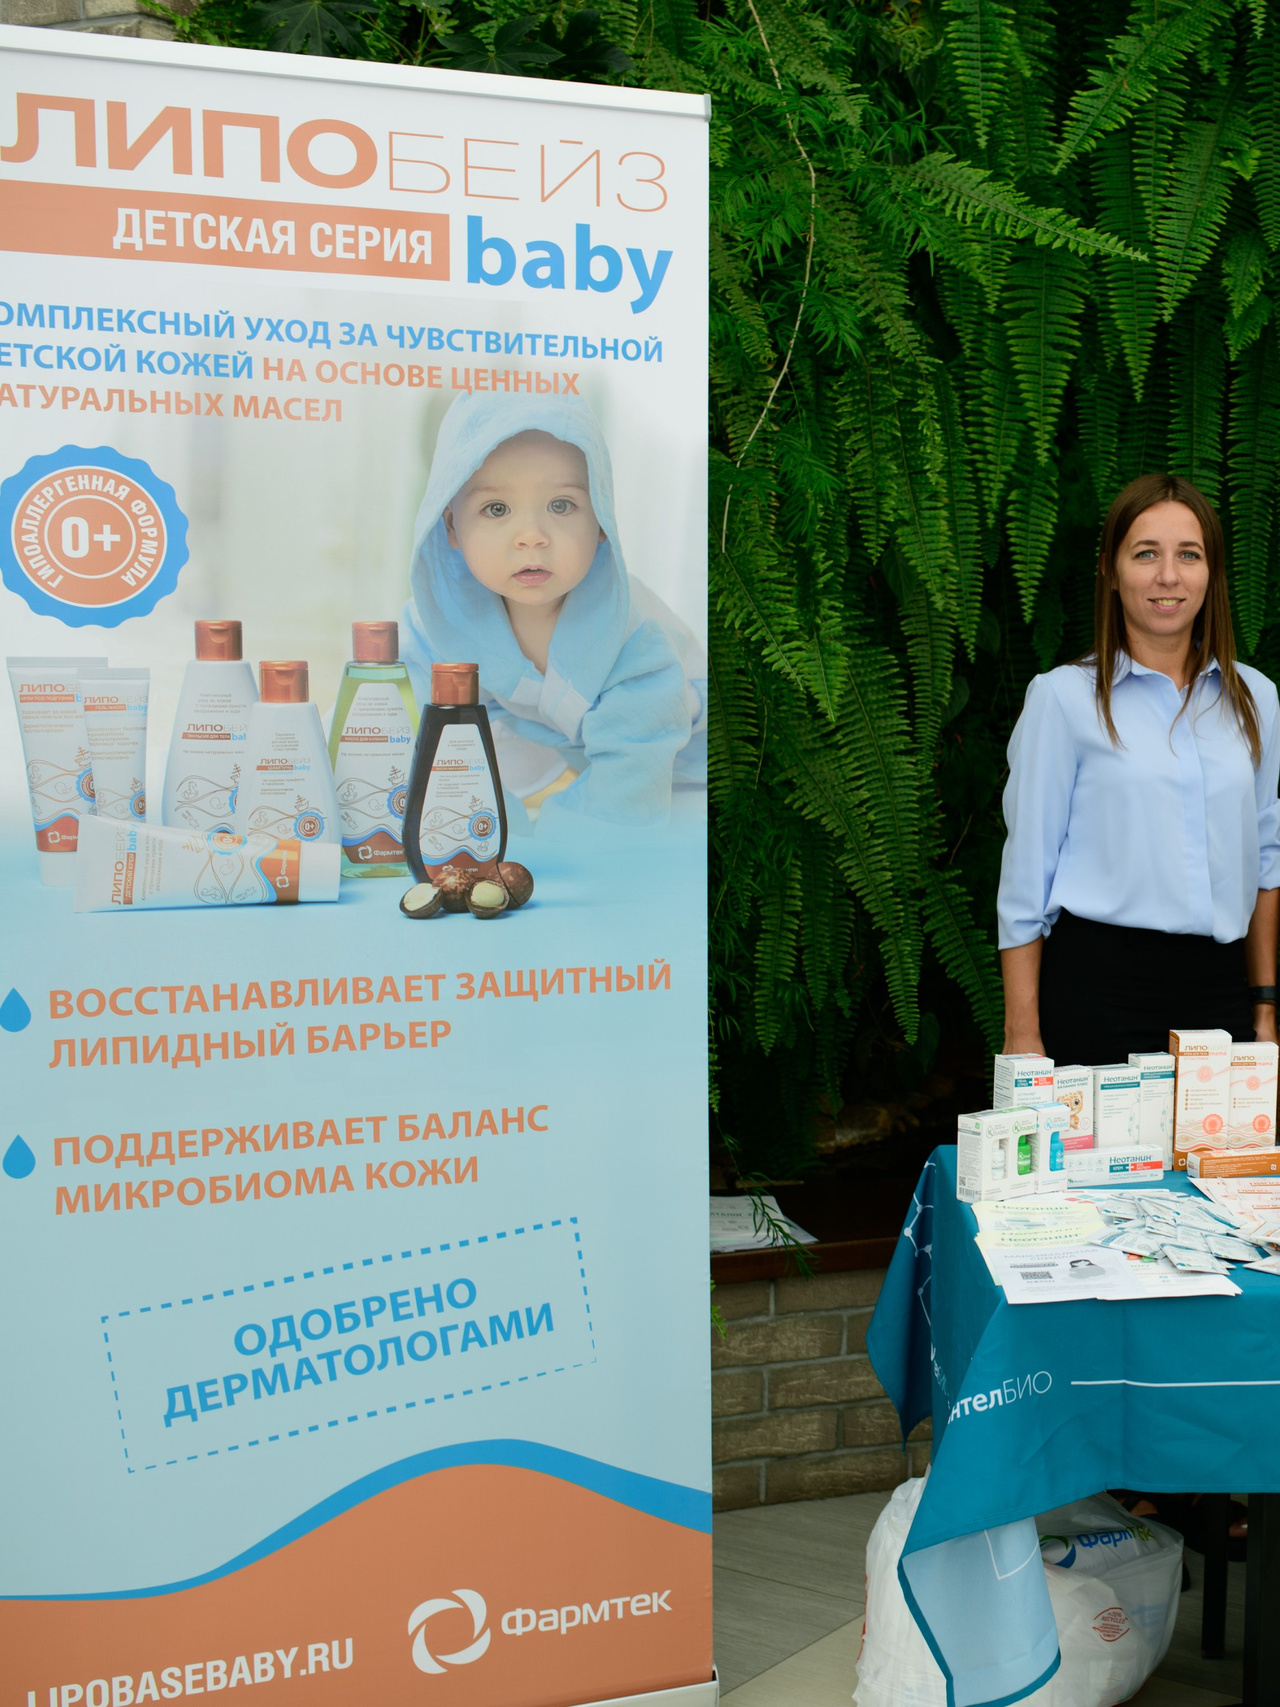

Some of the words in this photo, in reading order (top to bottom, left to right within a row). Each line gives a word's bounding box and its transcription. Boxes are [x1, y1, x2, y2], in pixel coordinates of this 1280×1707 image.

[0, 91, 669, 213] ЛИПОБЕЙЗ
[112, 207, 297, 258] ДЕТСКАЯ
[309, 220, 434, 265] СЕРИЯ
[467, 215, 674, 314] baby
[0, 301, 235, 341] ОМПЛЕКСНЫЙ
[243, 315, 331, 349] УХОД
[339, 321, 378, 347] ЗА
[386, 324, 664, 363] ЧУВСТВИТЕЛЬНОЙ
[0, 342, 126, 373] ЕТСКОЙ
[136, 347, 253, 379] КОЖЕЙ
[262, 357, 306, 383] НА
[314, 359, 443, 389] ОСНОВЕ
[451, 366, 580, 397] ЦЕННЫХ
[0, 383, 224, 419] АТУРАЛЬНЫХ
[233, 395, 343, 422] МАСЕЛ
[21, 474, 131, 589] ГИПОАЛЛЕРГЕННАЯ
[120, 499, 158, 587] ФОРМУЛА
[61, 516, 121, 559] 0+
[390, 735, 411, 745] baby
[48, 973, 447, 1019] ВОССТАНАВЛИВАЕТ
[456, 958, 672, 1002] ЗАЩИТНЫЙ
[49, 1021, 296, 1069] ЛИПИДНЫЙ
[306, 1020, 452, 1054] БАРЬЕР
[53, 1115, 388, 1167] ПОДДЕРЖИВАЕТ
[398, 1104, 549, 1142] БАЛАНС
[54, 1163, 355, 1216] МИКРОБИОМА
[365, 1156, 479, 1190] КОЖИ
[233, 1277, 478, 1360] ОДОБРЕНО
[162, 1302, 556, 1427] ДЕРМАТОЛОГАМИ
[500, 1589, 673, 1637] Фармтек
